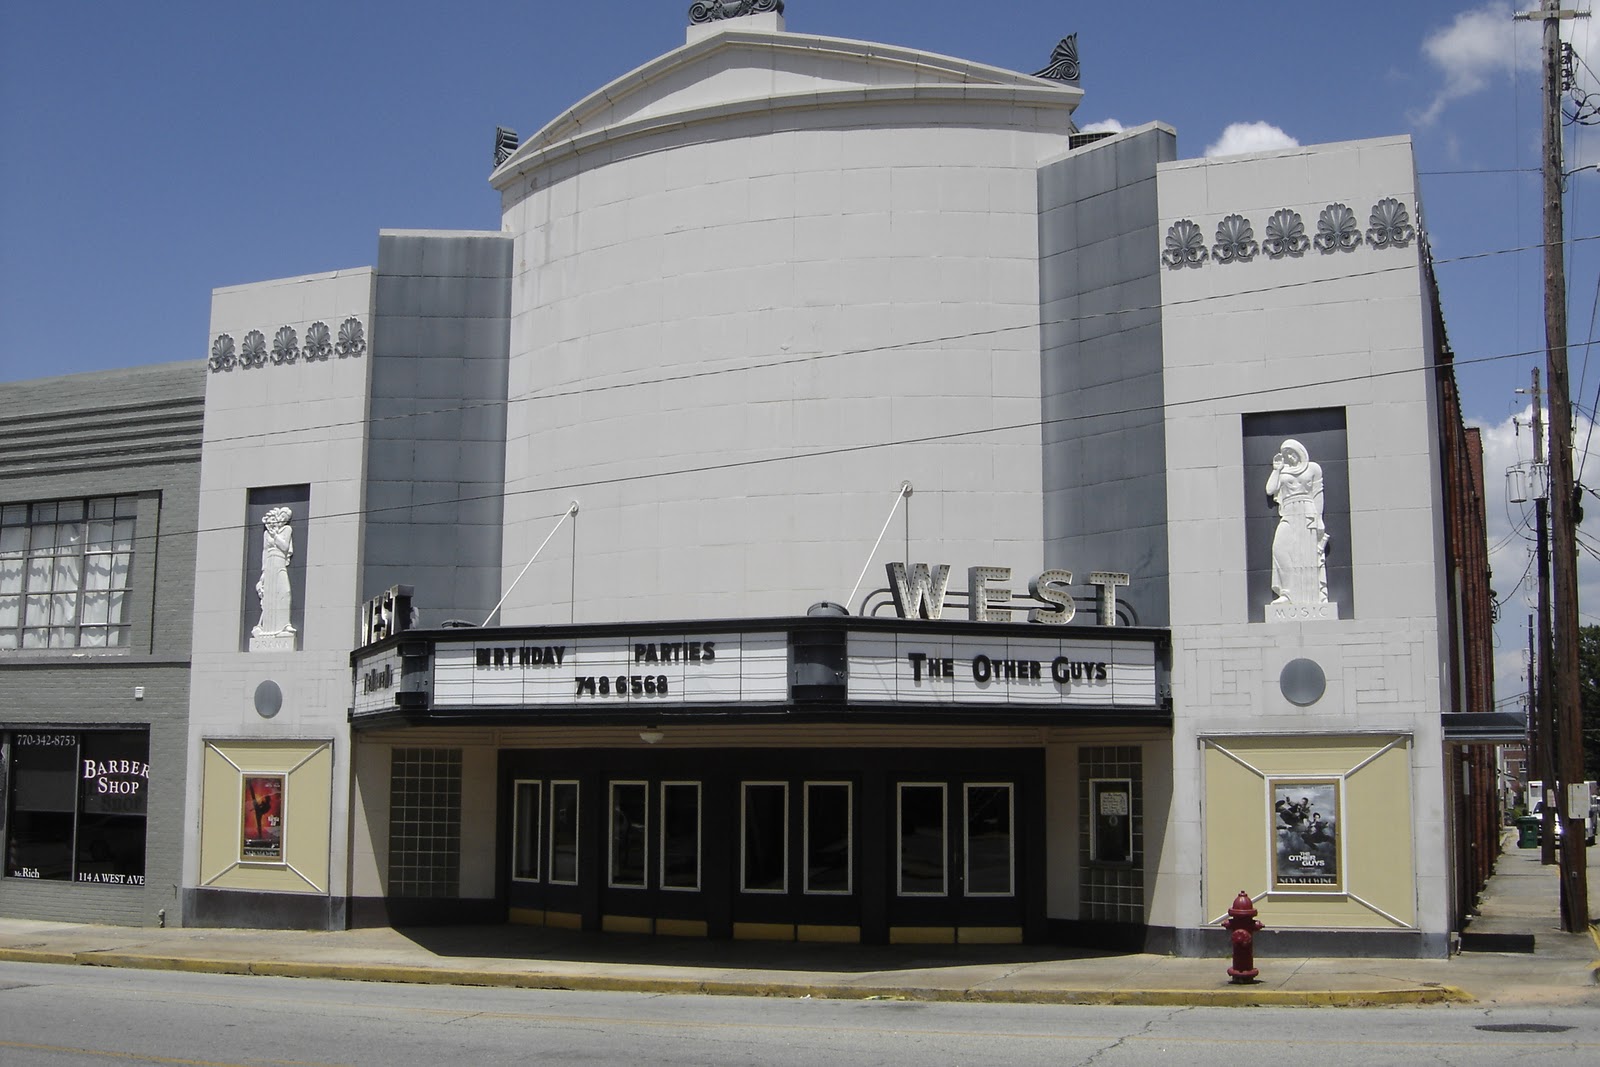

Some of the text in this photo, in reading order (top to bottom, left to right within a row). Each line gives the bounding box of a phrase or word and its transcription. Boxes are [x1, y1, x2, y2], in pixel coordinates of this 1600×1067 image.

[885, 562, 1129, 626] WEST
[476, 642, 715, 666] BIRTHDAY PARTIES
[908, 652, 1107, 684] THE OTHER GUYS
[17, 734, 76, 746] 770-342-8753
[83, 759, 150, 779] BARBER
[98, 777, 139, 794] SHOP
[22, 868, 40, 879] Rich
[79, 872, 145, 885] 114 A WEST AVE
